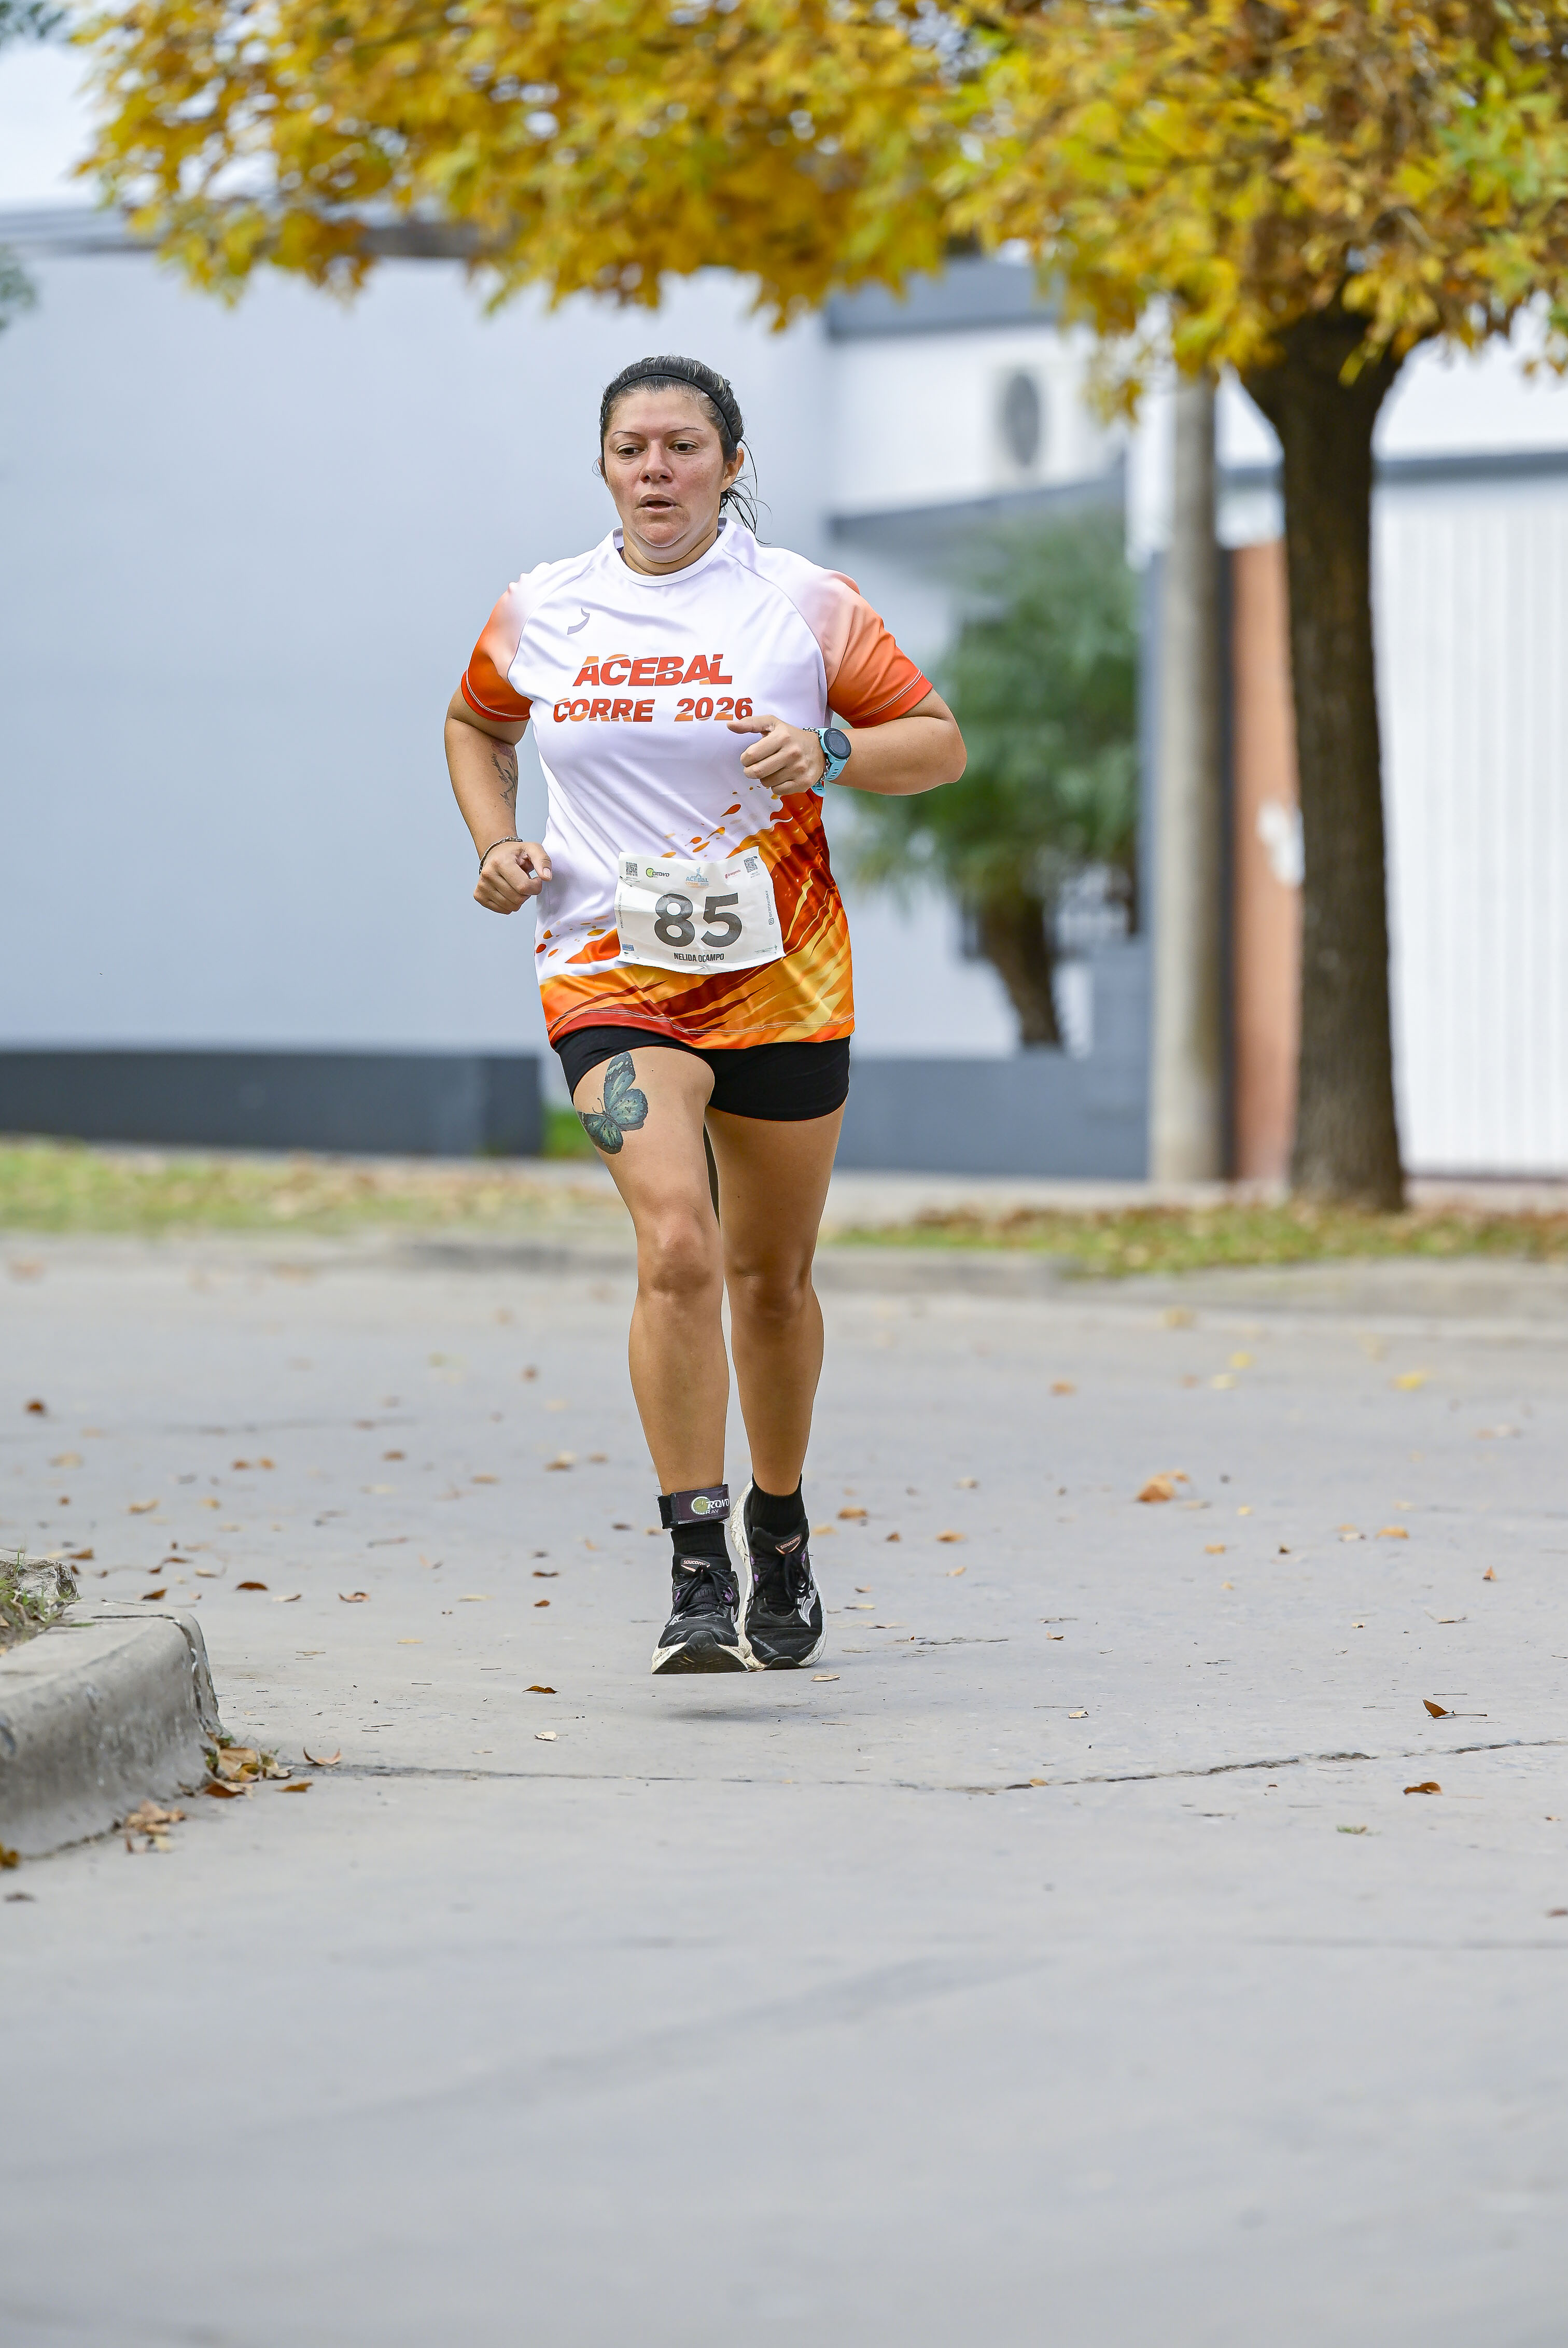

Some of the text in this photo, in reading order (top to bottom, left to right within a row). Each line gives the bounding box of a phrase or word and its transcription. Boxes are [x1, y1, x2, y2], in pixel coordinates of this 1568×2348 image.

[572, 654, 732, 686] ACEBAL
[553, 697, 753, 722] CORRE 2026
[654, 892, 742, 947] 85
[674, 953, 724, 963] NELIDA OCAMPO
[780, 1535, 800, 1549] saucony
